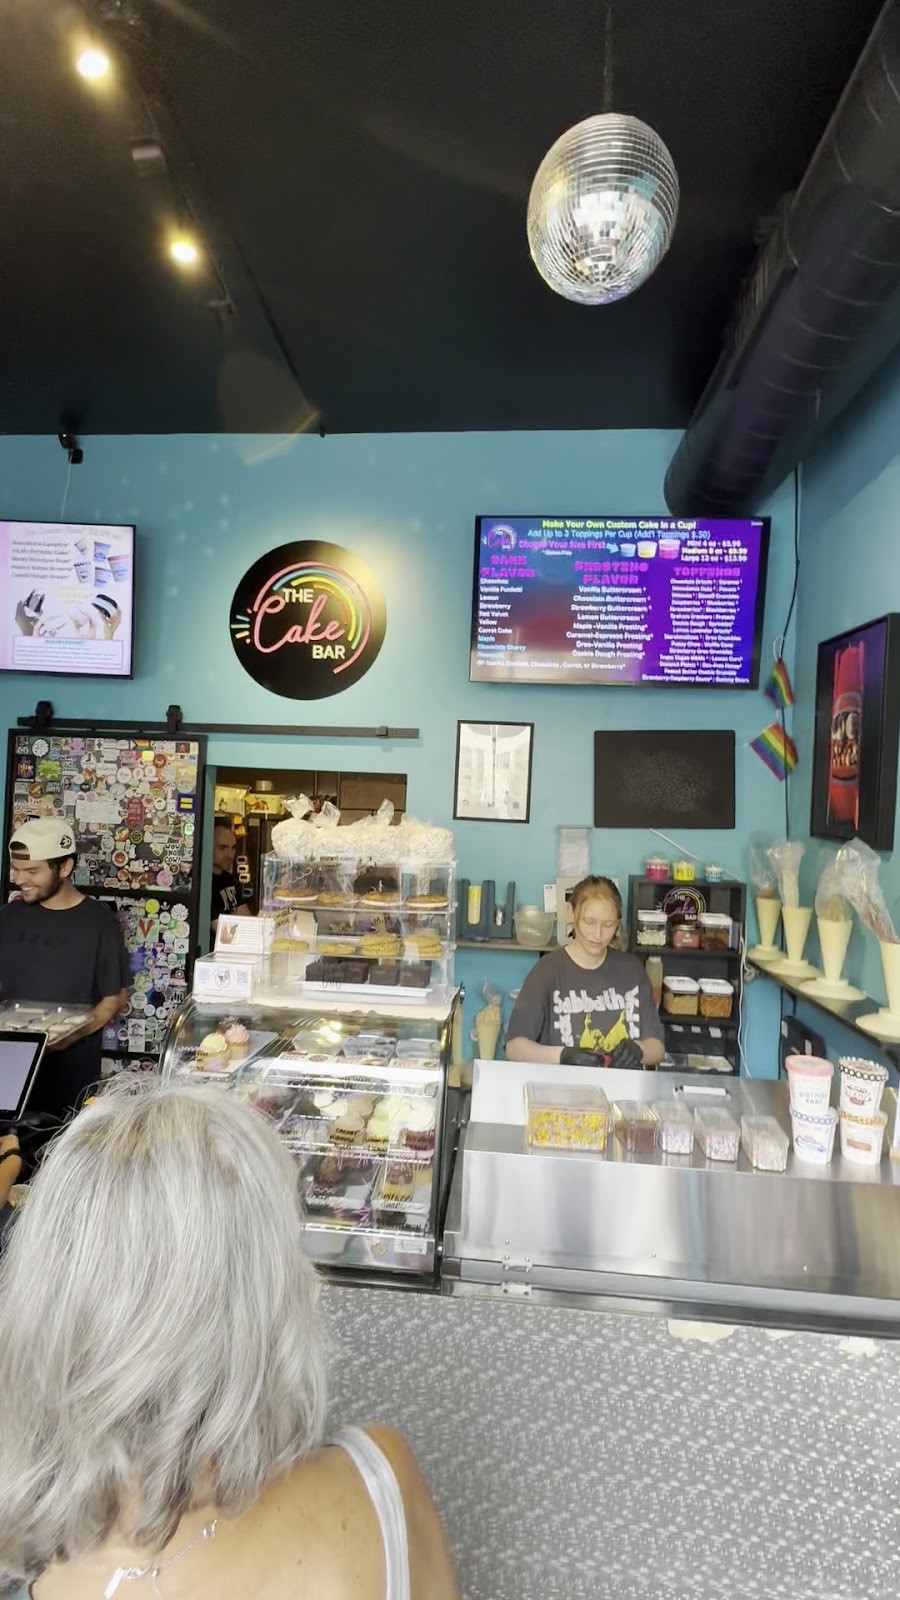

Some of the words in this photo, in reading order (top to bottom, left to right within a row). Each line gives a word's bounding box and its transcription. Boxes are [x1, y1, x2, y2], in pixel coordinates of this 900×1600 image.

[542, 520, 564, 528] Make
[565, 520, 584, 528] Your
[586, 520, 605, 528] Own
[606, 521, 637, 529] Custom
[638, 521, 659, 529] Cake
[527, 530, 541, 538] Add
[543, 530, 554, 538] Up
[555, 530, 563, 538] to
[564, 530, 569, 538] 3
[572, 530, 603, 539] Toppings
[618, 531, 632, 539] Cup
[657, 531, 689, 539] Toppings
[518, 540, 548, 549] Choose
[549, 540, 568, 549] Your
[569, 540, 586, 549] Size
[587, 540, 605, 549] First
[490, 555, 527, 565] CAKE
[574, 562, 649, 572] FROSTING
[673, 567, 741, 576] TOPPINGS
[480, 567, 535, 578] FLAVOR
[582, 574, 639, 584] FLAVOR
[601, 586, 642, 594] Buttercream
[282, 588, 314, 603] THE
[605, 595, 646, 603] Buttercream
[571, 604, 606, 612] Strawberry
[254, 594, 345, 653] Cake
[618, 623, 645, 631] Frosting
[624, 632, 651, 641] Frosting
[506, 644, 527, 652] Cherry
[616, 642, 643, 651] Frosting
[312, 645, 345, 659] BAR
[594, 650, 616, 658] Dough
[616, 651, 643, 659] Frosting
[553, 987, 625, 1013] Sabbath
